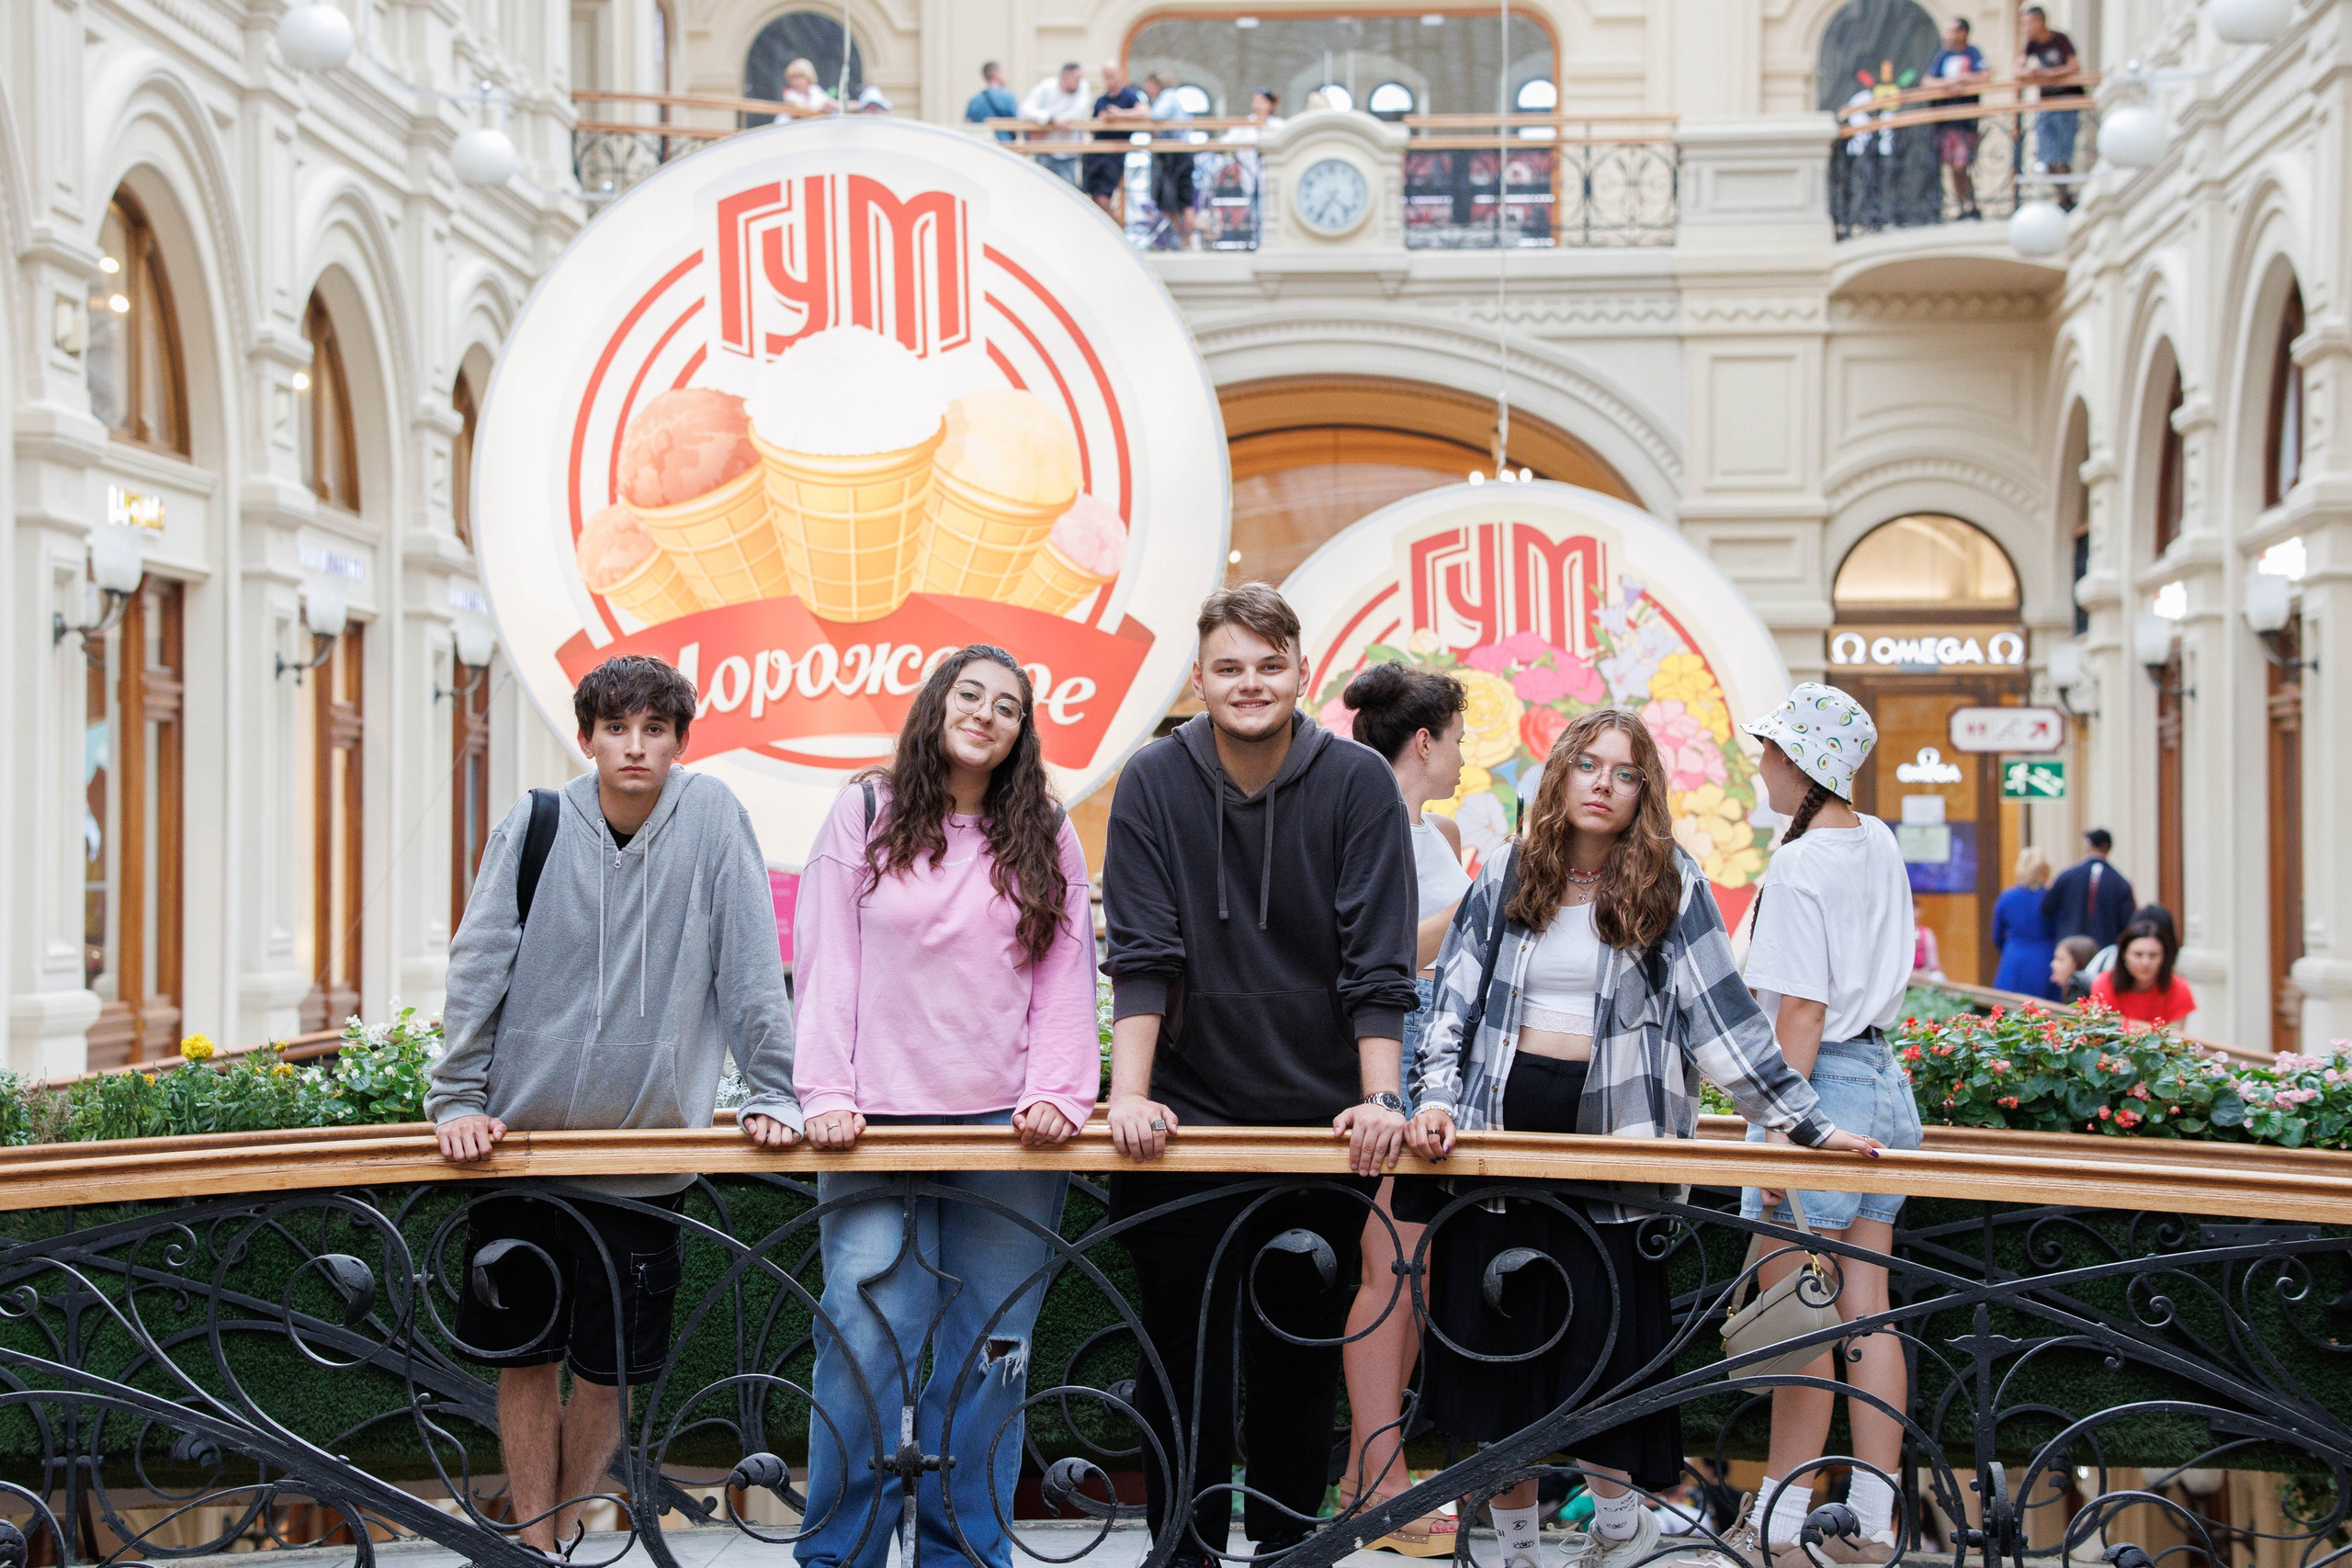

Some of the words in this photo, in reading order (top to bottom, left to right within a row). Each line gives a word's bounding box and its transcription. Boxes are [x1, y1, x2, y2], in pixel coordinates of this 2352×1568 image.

[717, 173, 971, 363] ГУМ
[1411, 522, 1607, 664] ГУМ
[1871, 636, 1985, 665] OMEGA
